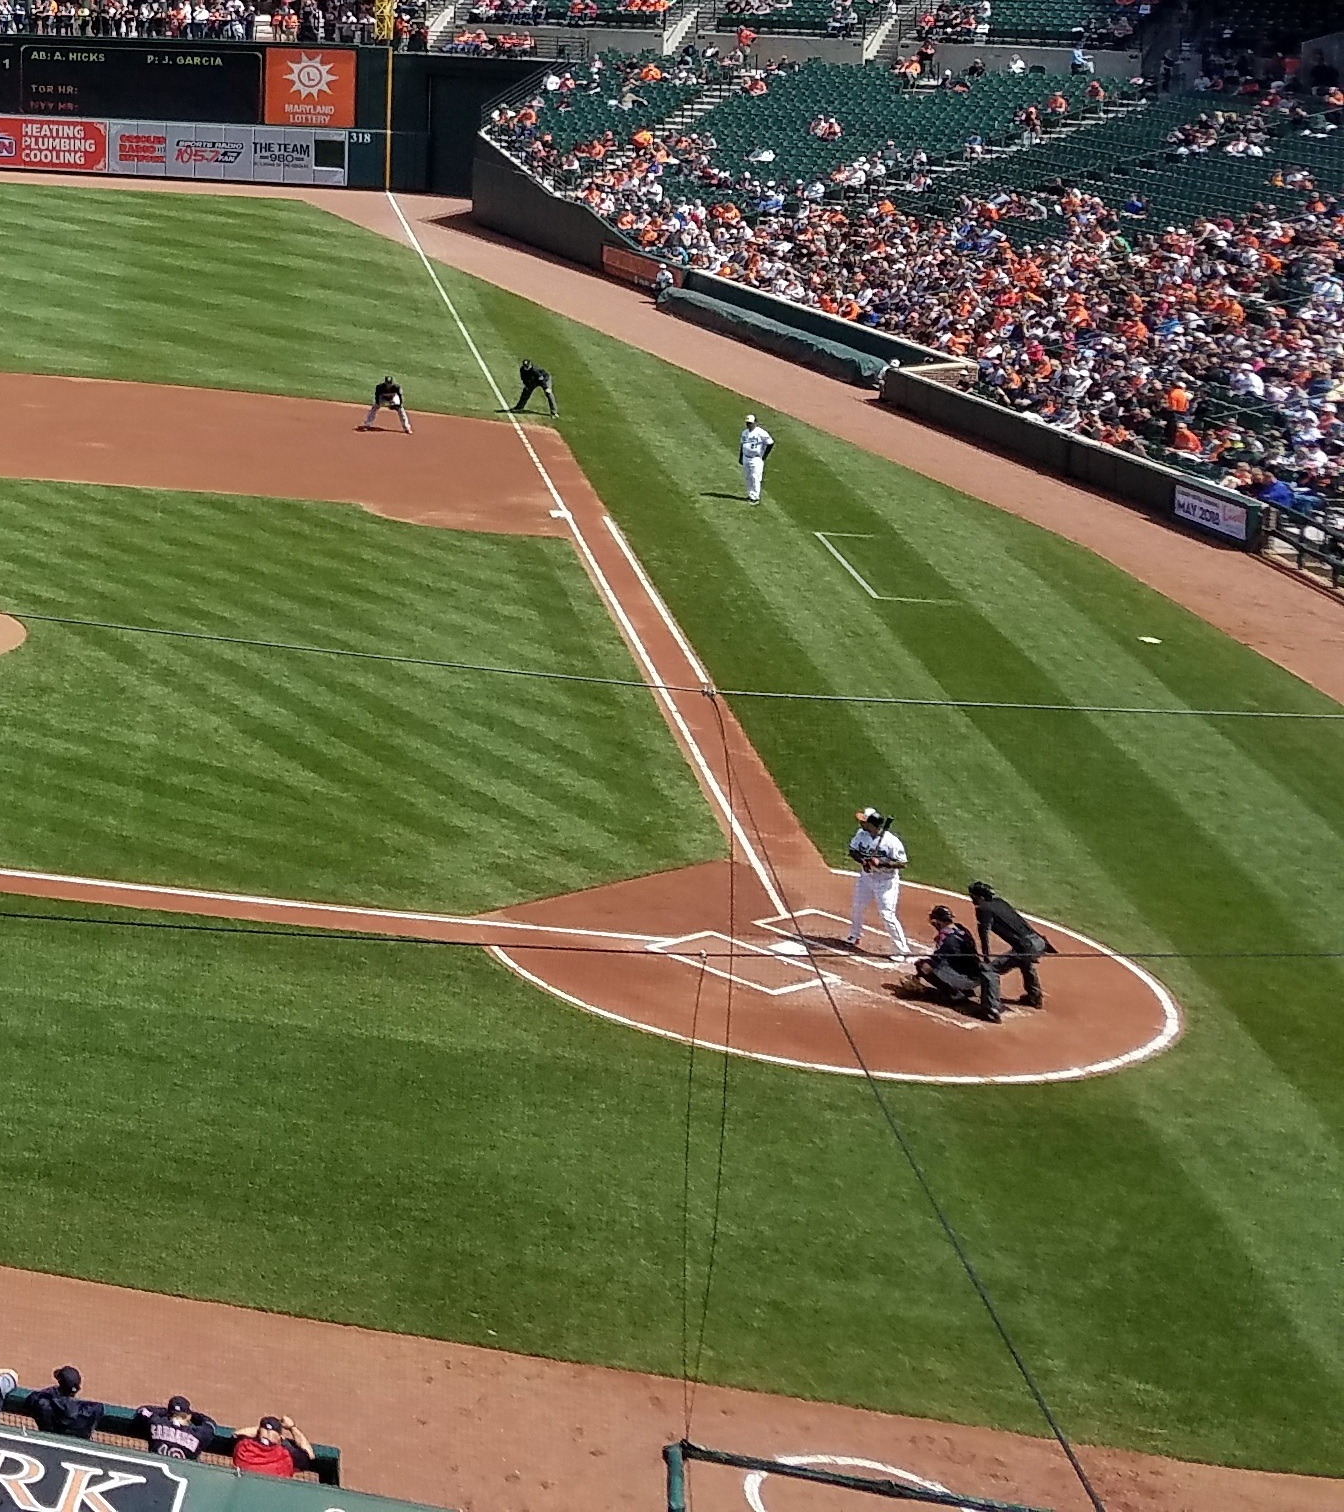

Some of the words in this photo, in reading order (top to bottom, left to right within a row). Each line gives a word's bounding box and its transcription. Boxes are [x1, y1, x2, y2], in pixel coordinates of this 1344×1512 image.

[31, 51, 51, 61] AB:
[54, 51, 66, 61] A.
[69, 51, 105, 62] HICKS
[176, 56, 223, 66] GARCIA
[3, 58, 10, 70] 1
[31, 84, 54, 94] TOR
[57, 84, 78, 94] HR:
[284, 103, 335, 115] MARYLAND
[289, 114, 331, 124] LOTTERY
[22, 123, 85, 139] HEATING
[350, 132, 371, 143] 318
[22, 137, 96, 152] PLUMBING
[178, 141, 212, 149] SPORTS
[252, 142, 276, 155] THE
[277, 143, 311, 158] TEAM
[22, 150, 85, 164] COOLING
[218, 155, 236, 163] FAN
[269, 154, 294, 163] 980
[1177, 500, 1197, 516] MAY
